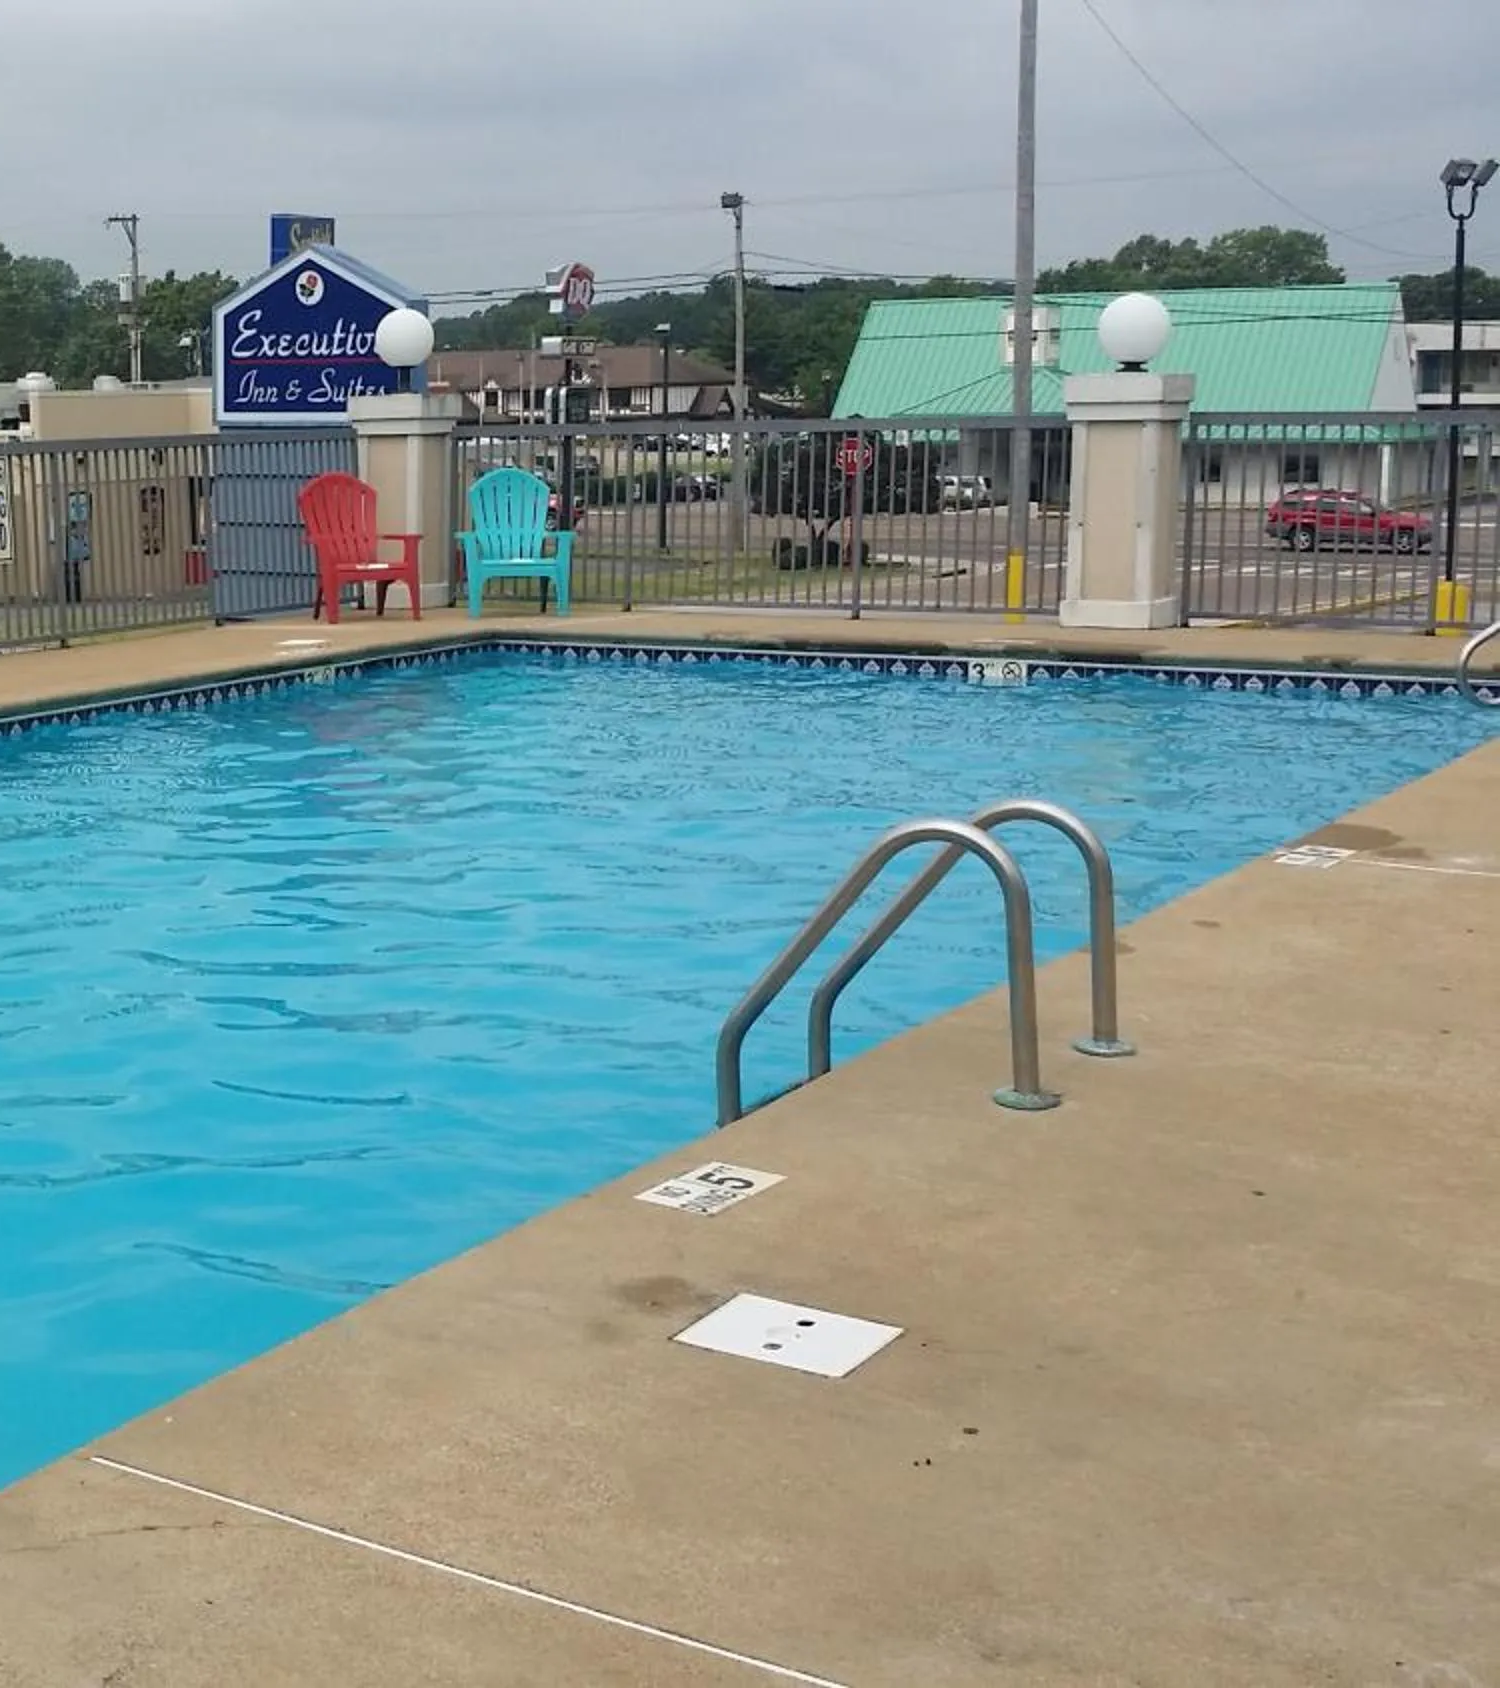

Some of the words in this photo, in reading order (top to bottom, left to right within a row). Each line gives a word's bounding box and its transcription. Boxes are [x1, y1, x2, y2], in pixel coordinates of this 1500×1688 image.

[232, 310, 374, 358] Executiv
[235, 369, 278, 403] Inn
[285, 381, 302, 400] &
[307, 368, 387, 404] Suites
[697, 1172, 755, 1189] 5
